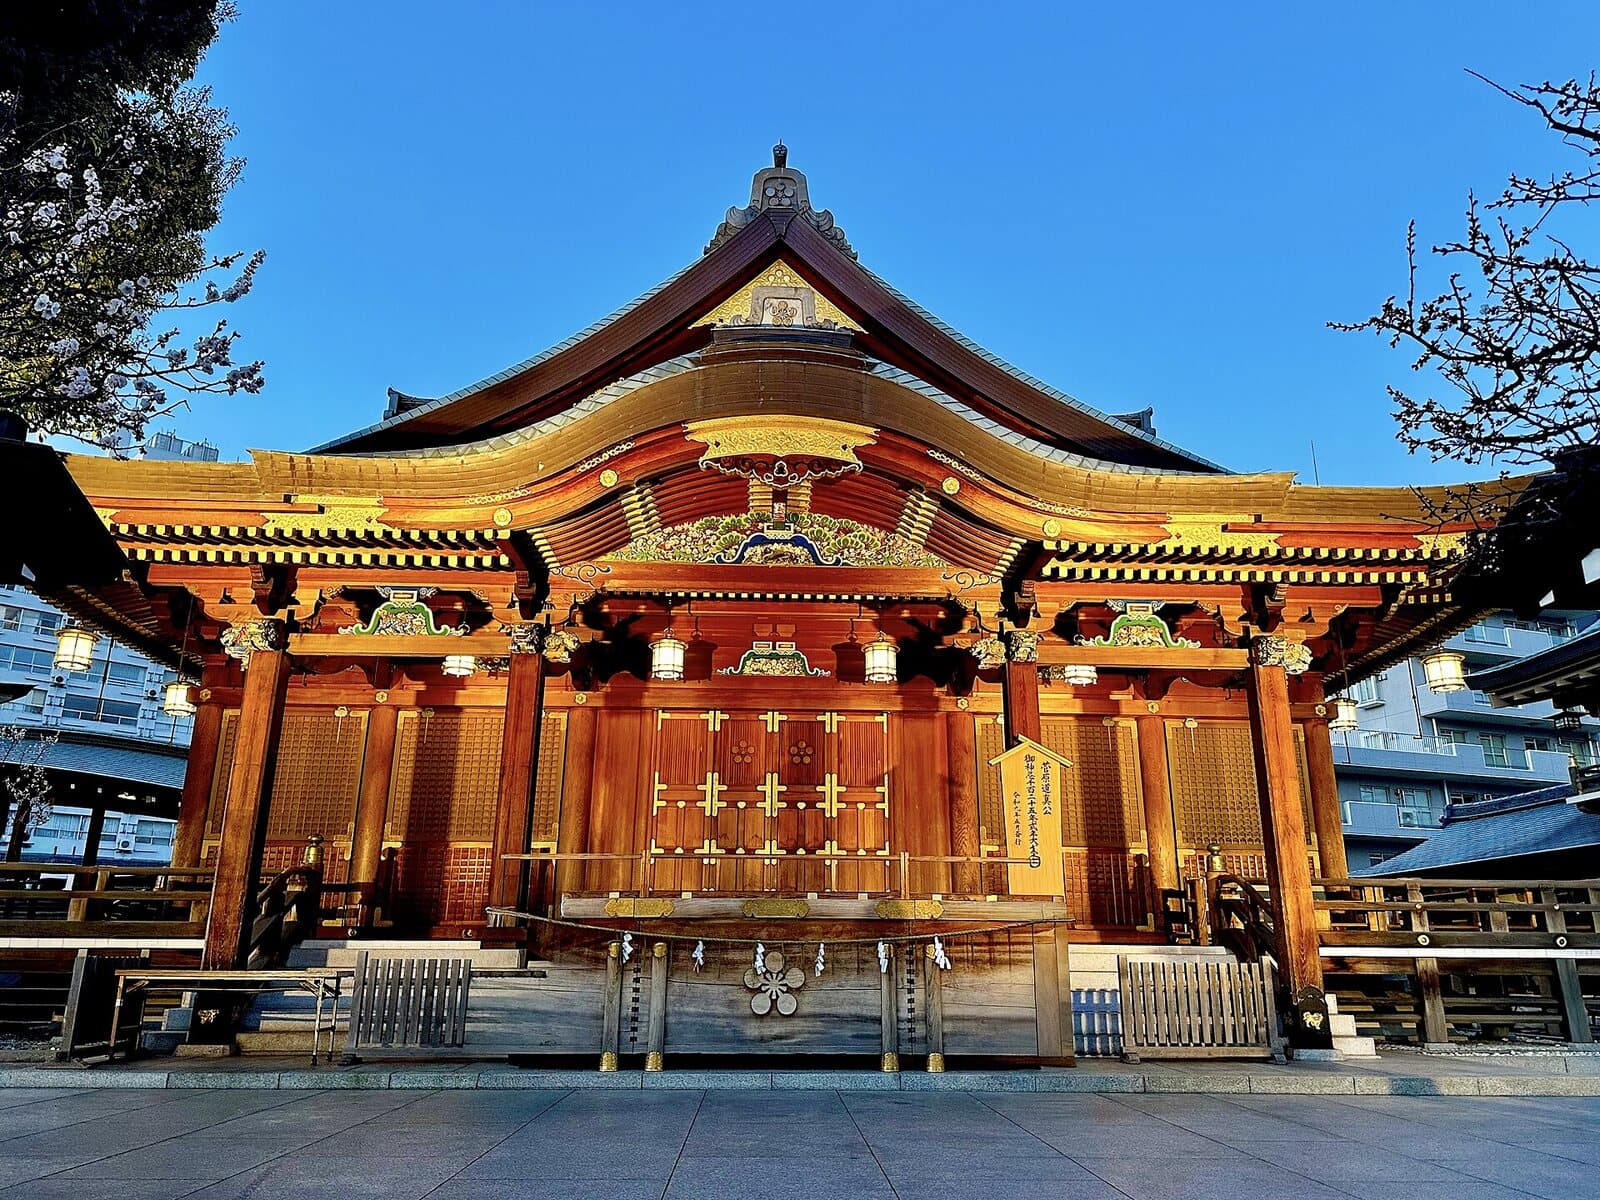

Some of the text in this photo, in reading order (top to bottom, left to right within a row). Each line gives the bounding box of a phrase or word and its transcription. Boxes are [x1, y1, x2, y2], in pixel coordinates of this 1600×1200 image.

[1041, 761, 1052, 815] 菅原道真公
